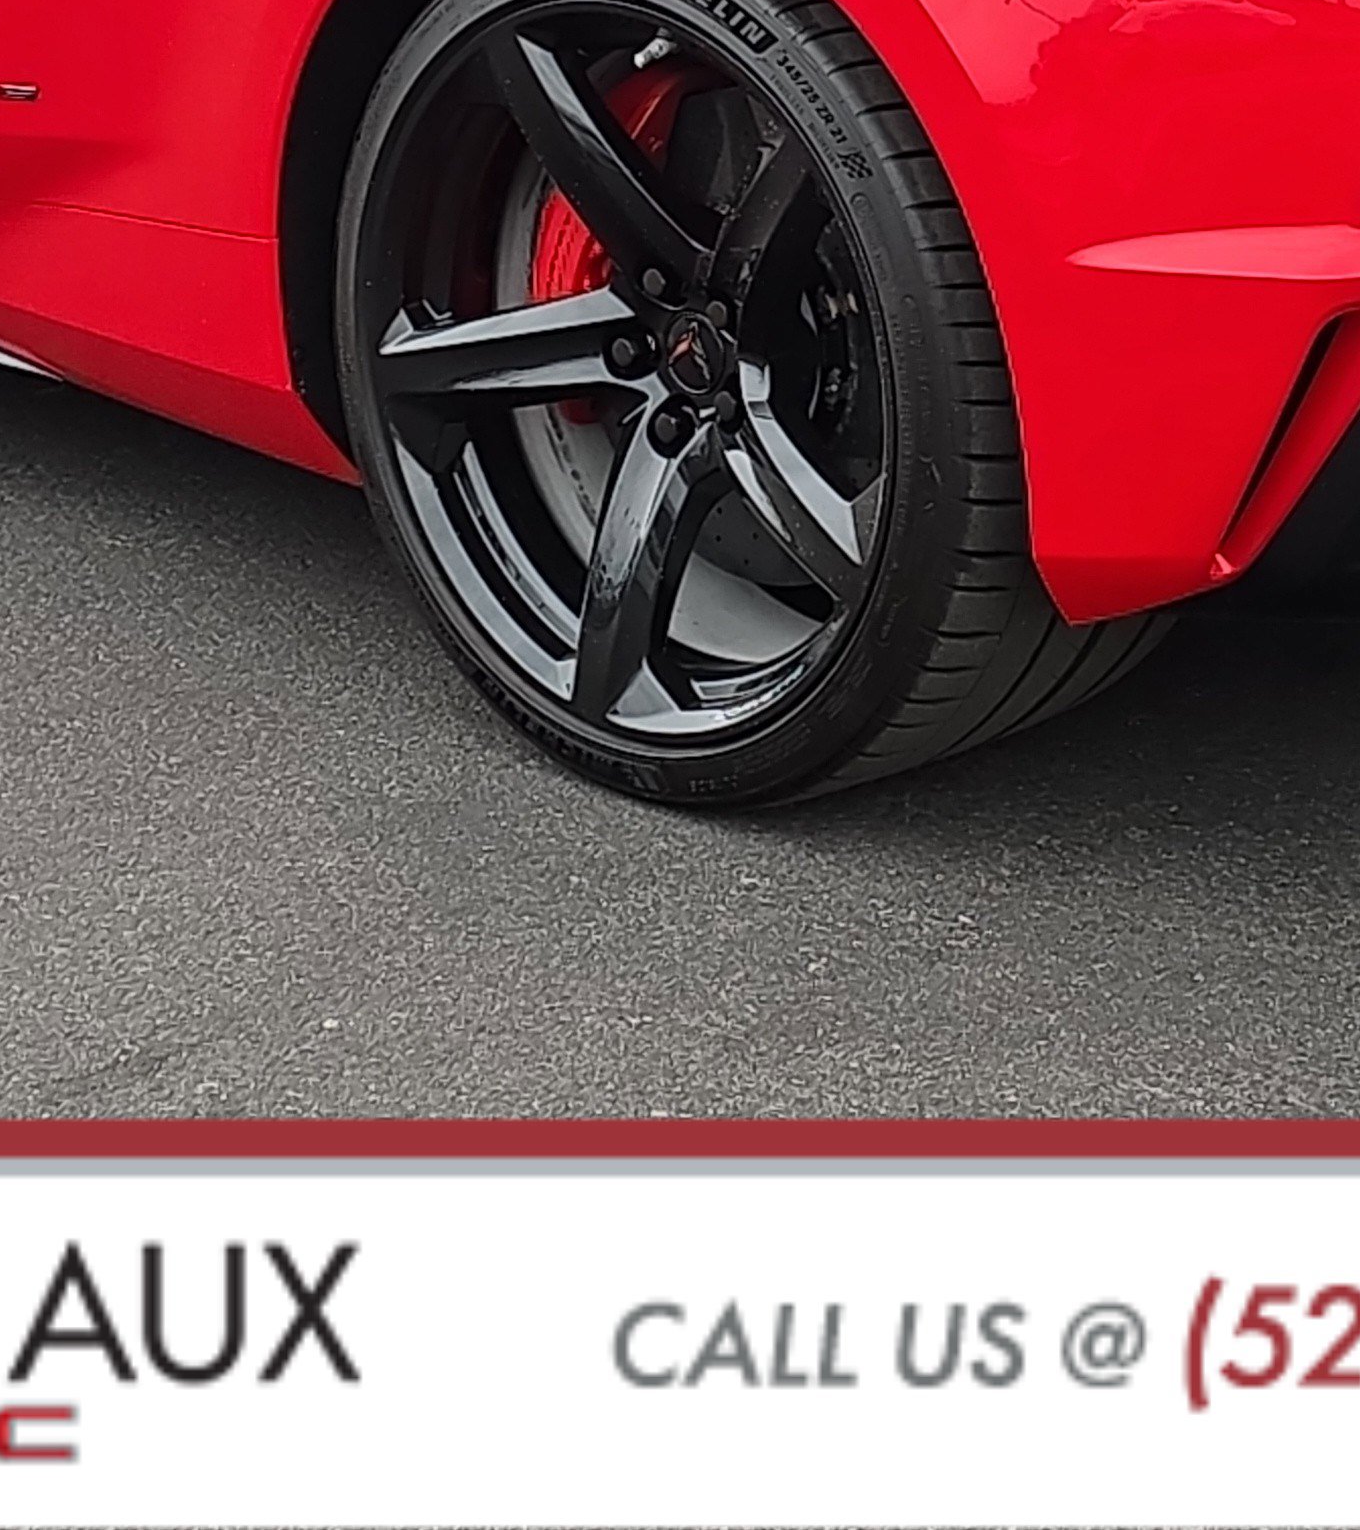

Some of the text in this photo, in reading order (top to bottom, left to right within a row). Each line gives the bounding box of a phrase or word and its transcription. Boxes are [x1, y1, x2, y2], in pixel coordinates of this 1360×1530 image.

[777, 54, 848, 144] 345/25 ZR 21
